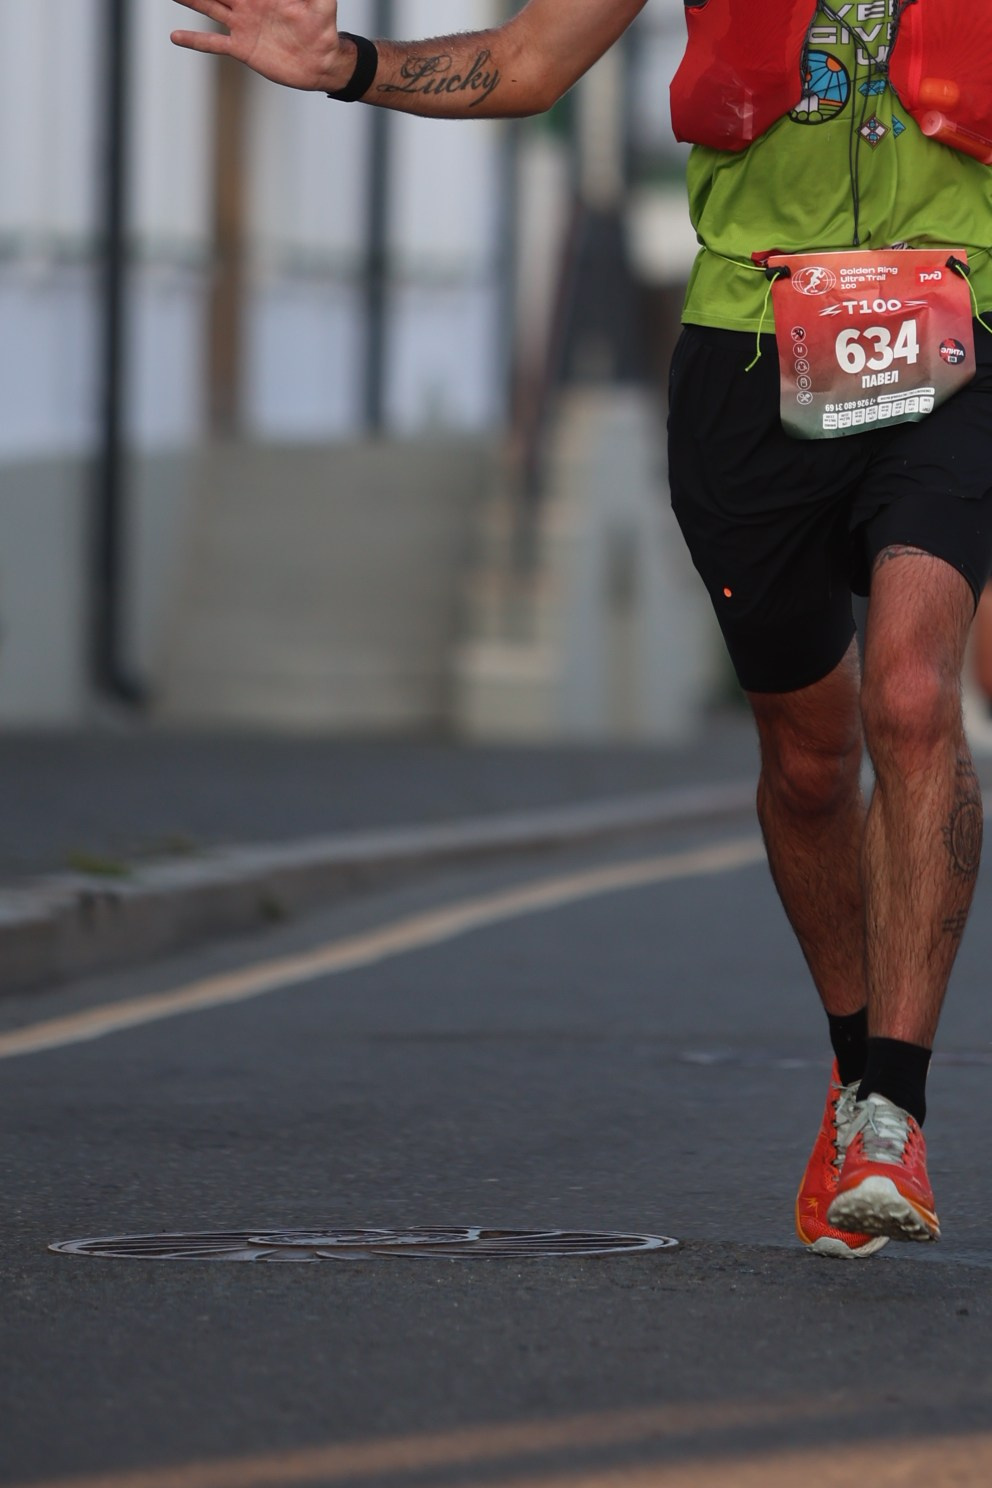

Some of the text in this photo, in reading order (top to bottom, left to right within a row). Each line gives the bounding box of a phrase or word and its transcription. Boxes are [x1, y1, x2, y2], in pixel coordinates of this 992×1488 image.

[376, 48, 500, 108] Lucky
[839, 266, 898, 276] Golden Ring
[840, 275, 865, 283] Ultra
[842, 299, 902, 314] T100
[835, 319, 920, 374] 634
[940, 347, 964, 357] ЭЛИТА
[861, 370, 899, 388] ПАВЕЛ
